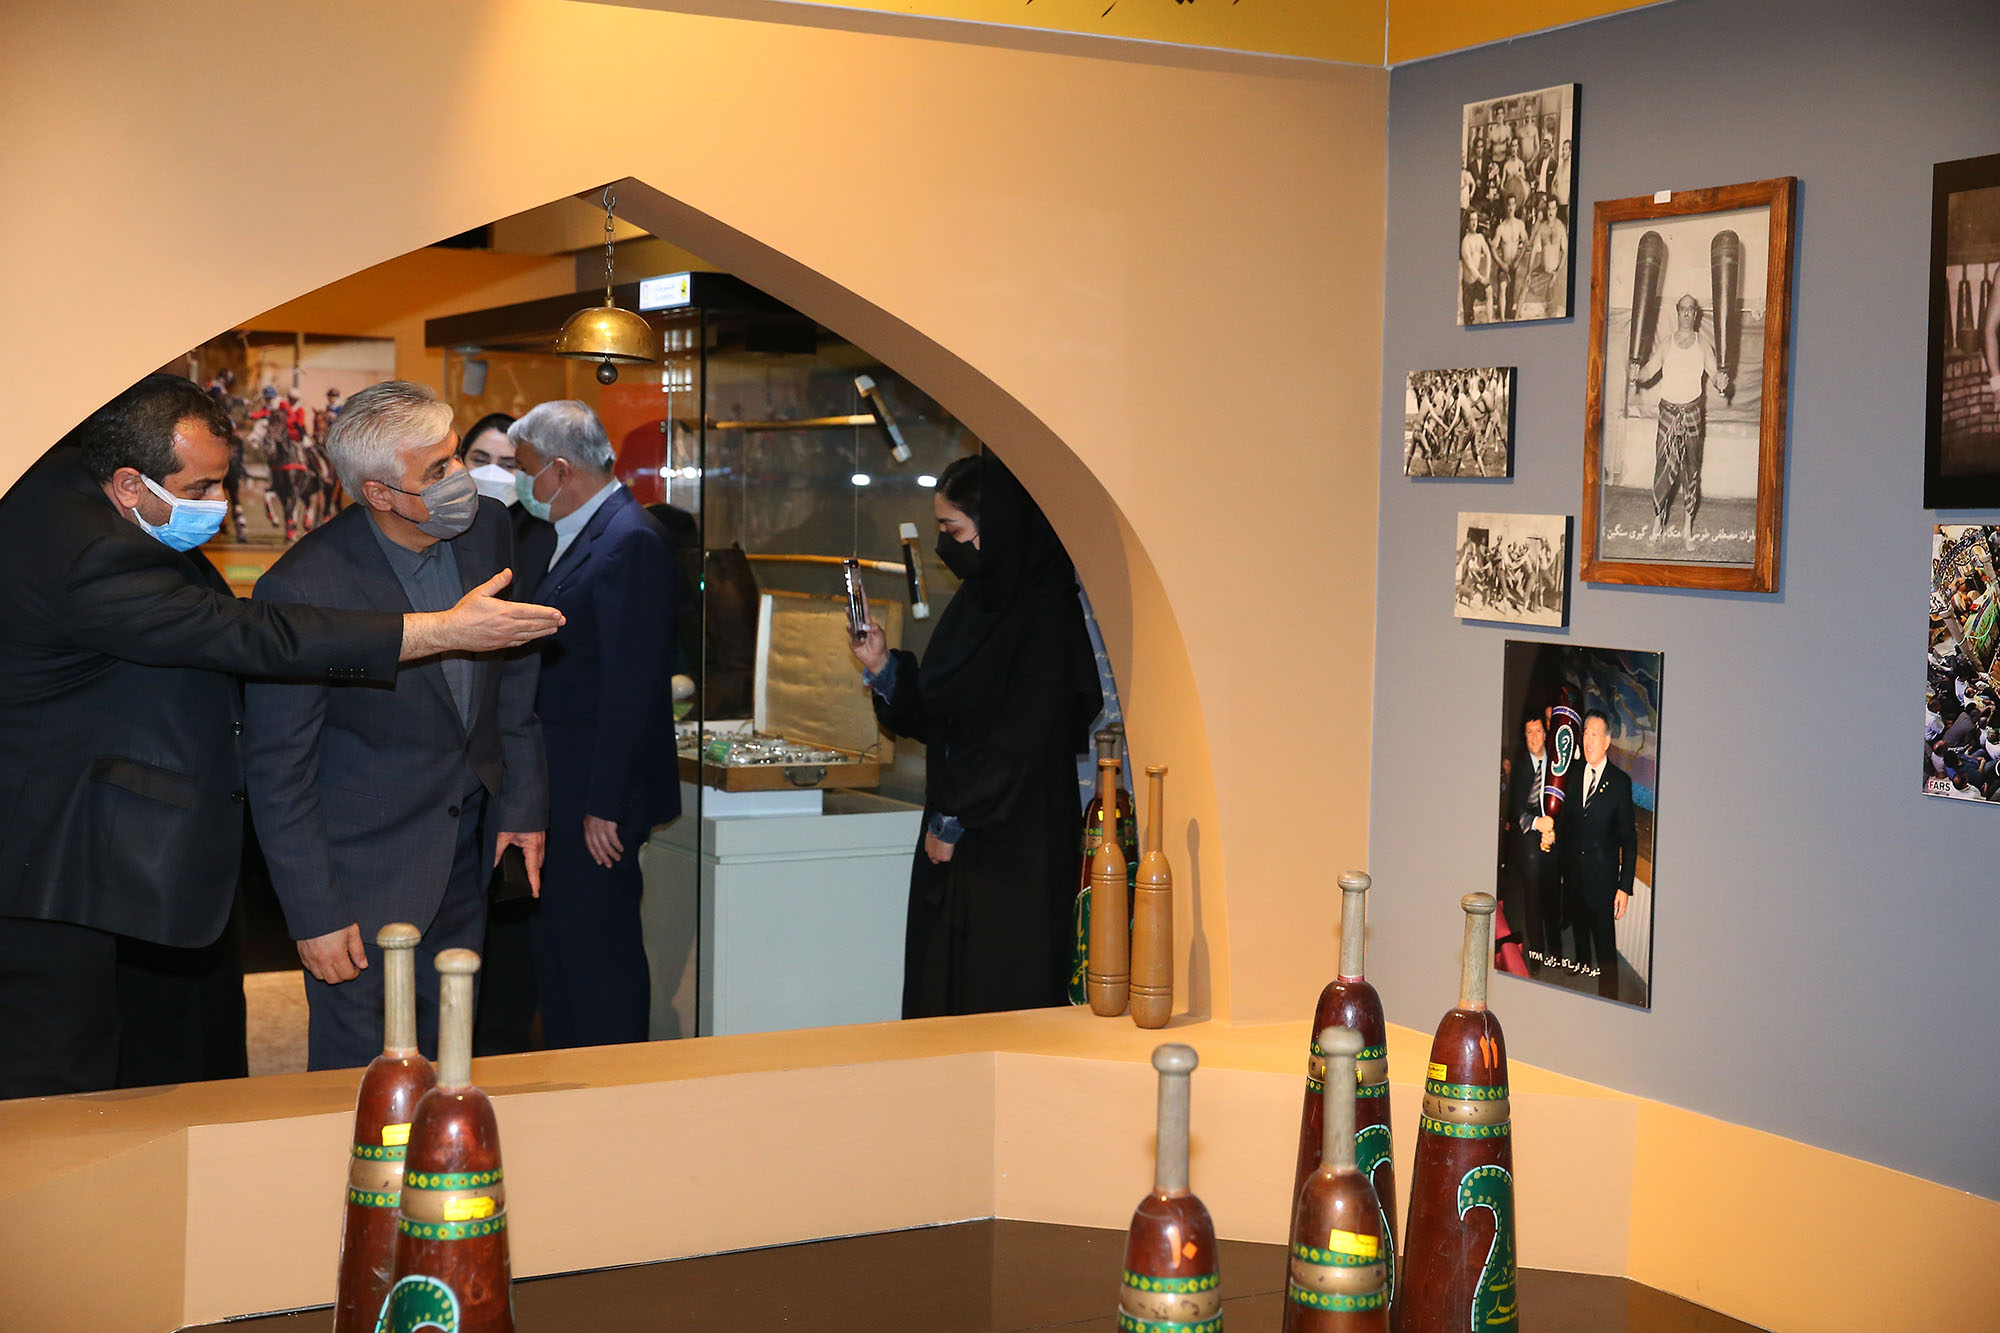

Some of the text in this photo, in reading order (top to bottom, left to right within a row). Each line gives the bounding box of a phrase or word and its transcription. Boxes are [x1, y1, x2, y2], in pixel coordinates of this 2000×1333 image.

[1629, 524, 1648, 541] گیری
[1711, 527, 1738, 542] مصطفی
[1740, 529, 1756, 543] لوان
[1929, 780, 1951, 792] FARS
[1561, 958, 1580, 972] اوساکا
